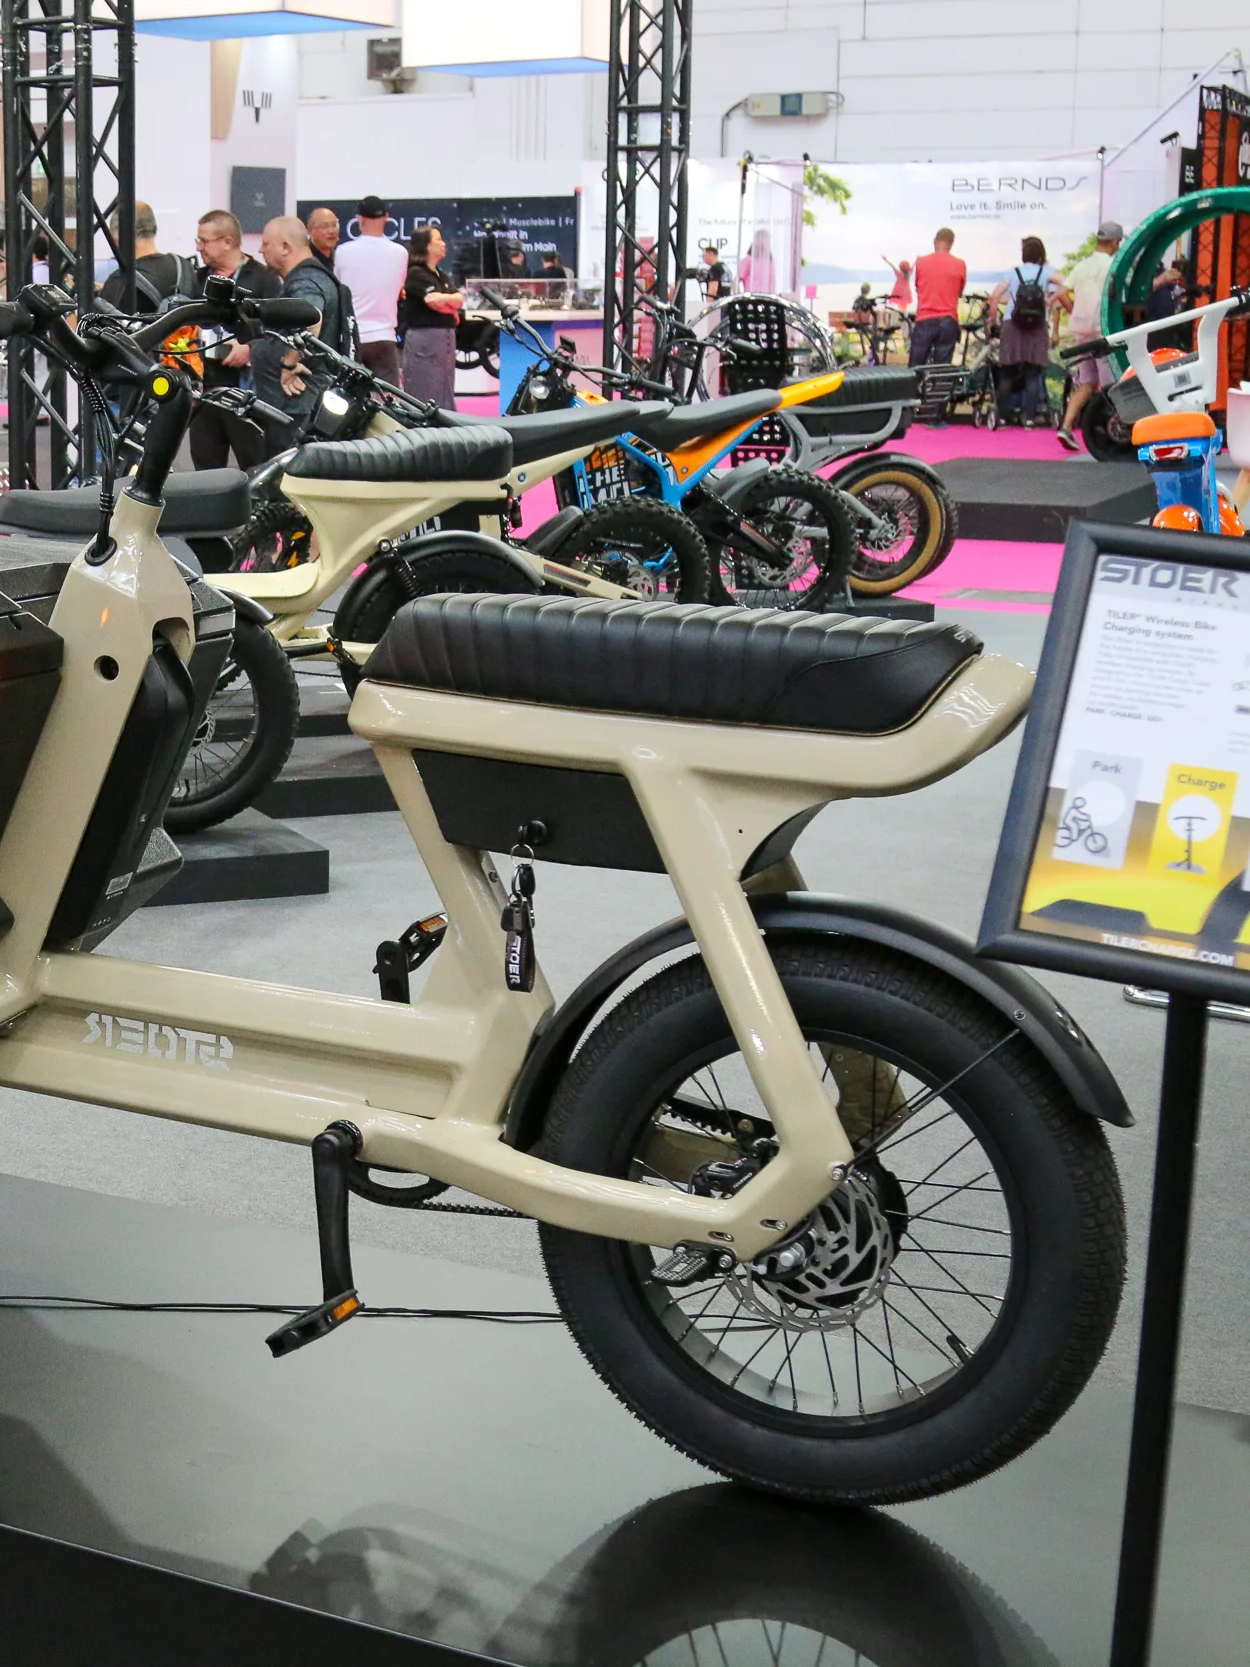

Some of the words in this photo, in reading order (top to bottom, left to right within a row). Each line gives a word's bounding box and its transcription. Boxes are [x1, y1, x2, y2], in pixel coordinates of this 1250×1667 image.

[951, 176, 1088, 193] BERNDS
[950, 201, 976, 211] Love
[1030, 201, 1048, 210] on.
[346, 216, 442, 241] CCL
[534, 241, 557, 252] Main
[1099, 557, 1240, 599] STOER
[1103, 621, 1152, 638] Charging
[1155, 630, 1194, 641] system
[1145, 615, 1190, 629] Wireless
[1194, 620, 1218, 631] Bike
[1092, 760, 1123, 774] Park
[1177, 773, 1227, 791] Charge
